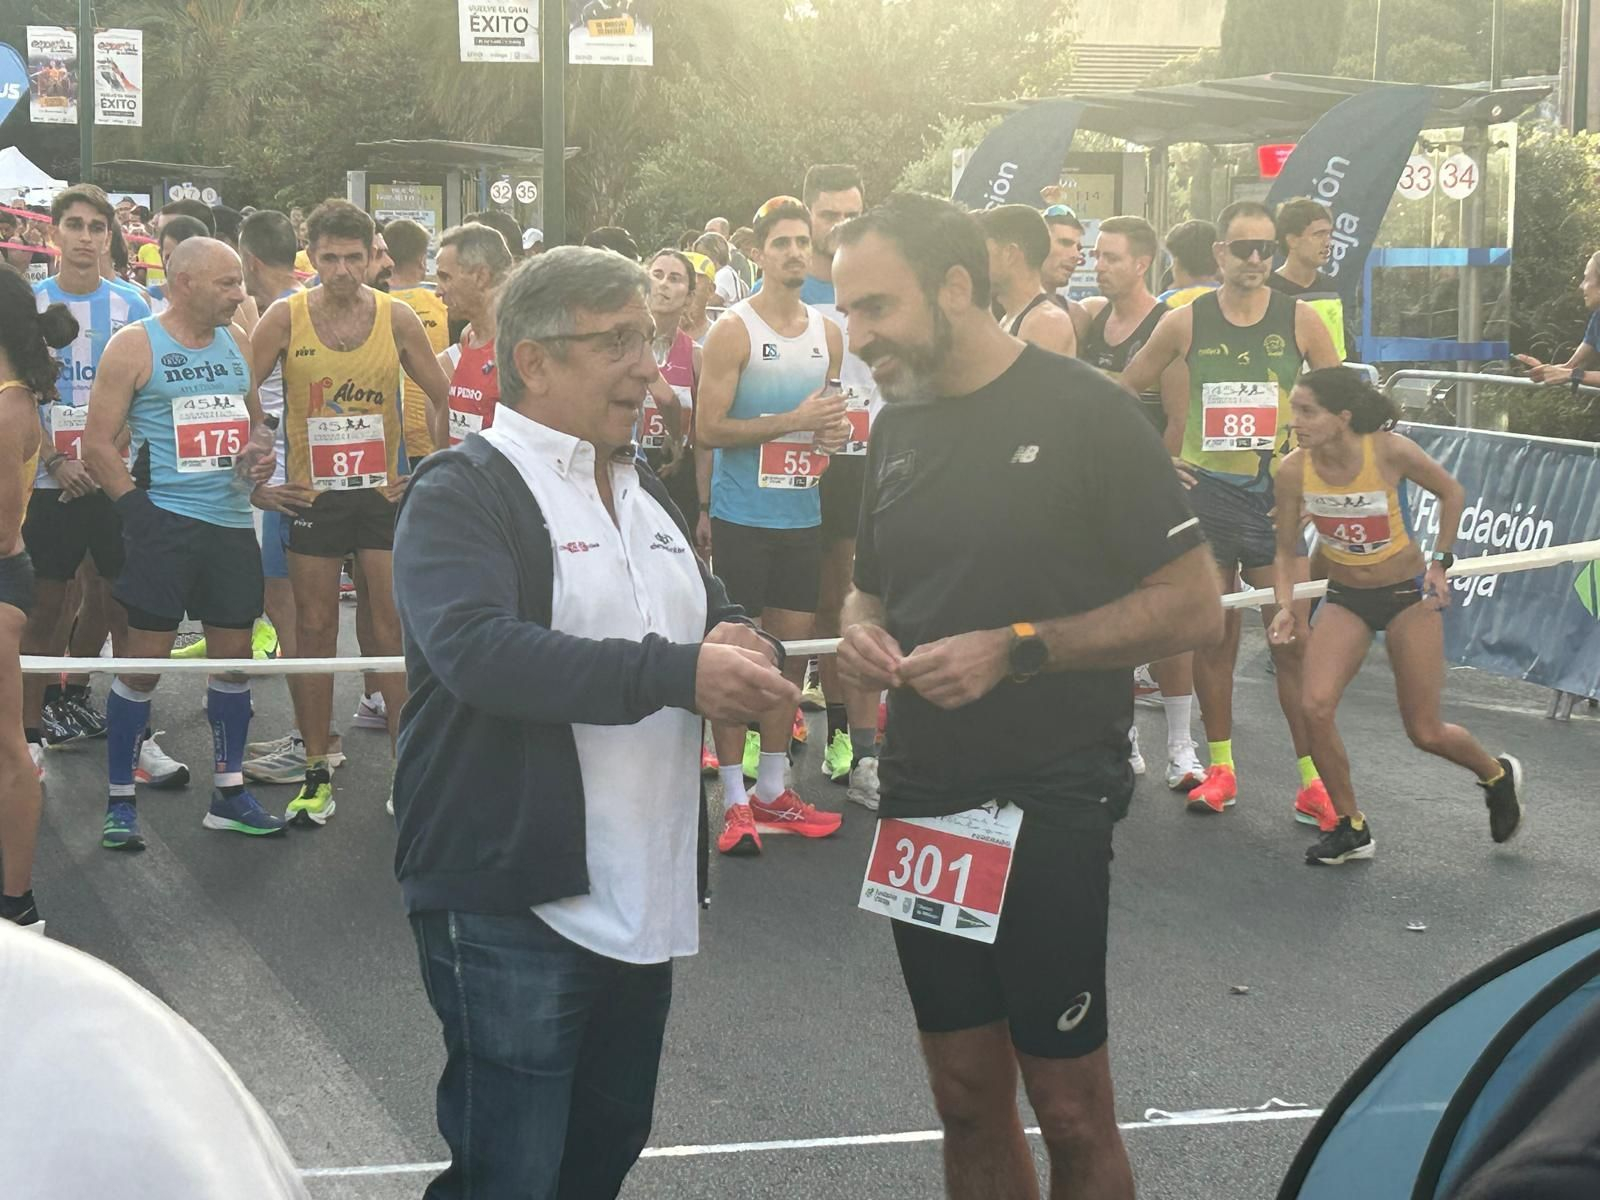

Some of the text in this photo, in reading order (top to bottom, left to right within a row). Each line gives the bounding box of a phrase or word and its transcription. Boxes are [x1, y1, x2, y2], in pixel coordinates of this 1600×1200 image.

[470, 12, 529, 33] ÉXITO
[100, 98, 137, 110] ÉXITO
[1306, 155, 1351, 207] ión
[1399, 164, 1431, 191] 33
[1443, 163, 1475, 189] 34
[493, 184, 510, 200] 32
[519, 184, 536, 200] 35
[164, 361, 229, 383] nerja
[334, 378, 385, 405] Álora
[1224, 414, 1256, 436] 88
[193, 428, 242, 457] 175
[332, 450, 365, 476] 87
[784, 450, 811, 475] 55
[1413, 489, 1555, 551] Fudación
[1333, 523, 1367, 543] 43
[888, 837, 973, 905] 301
